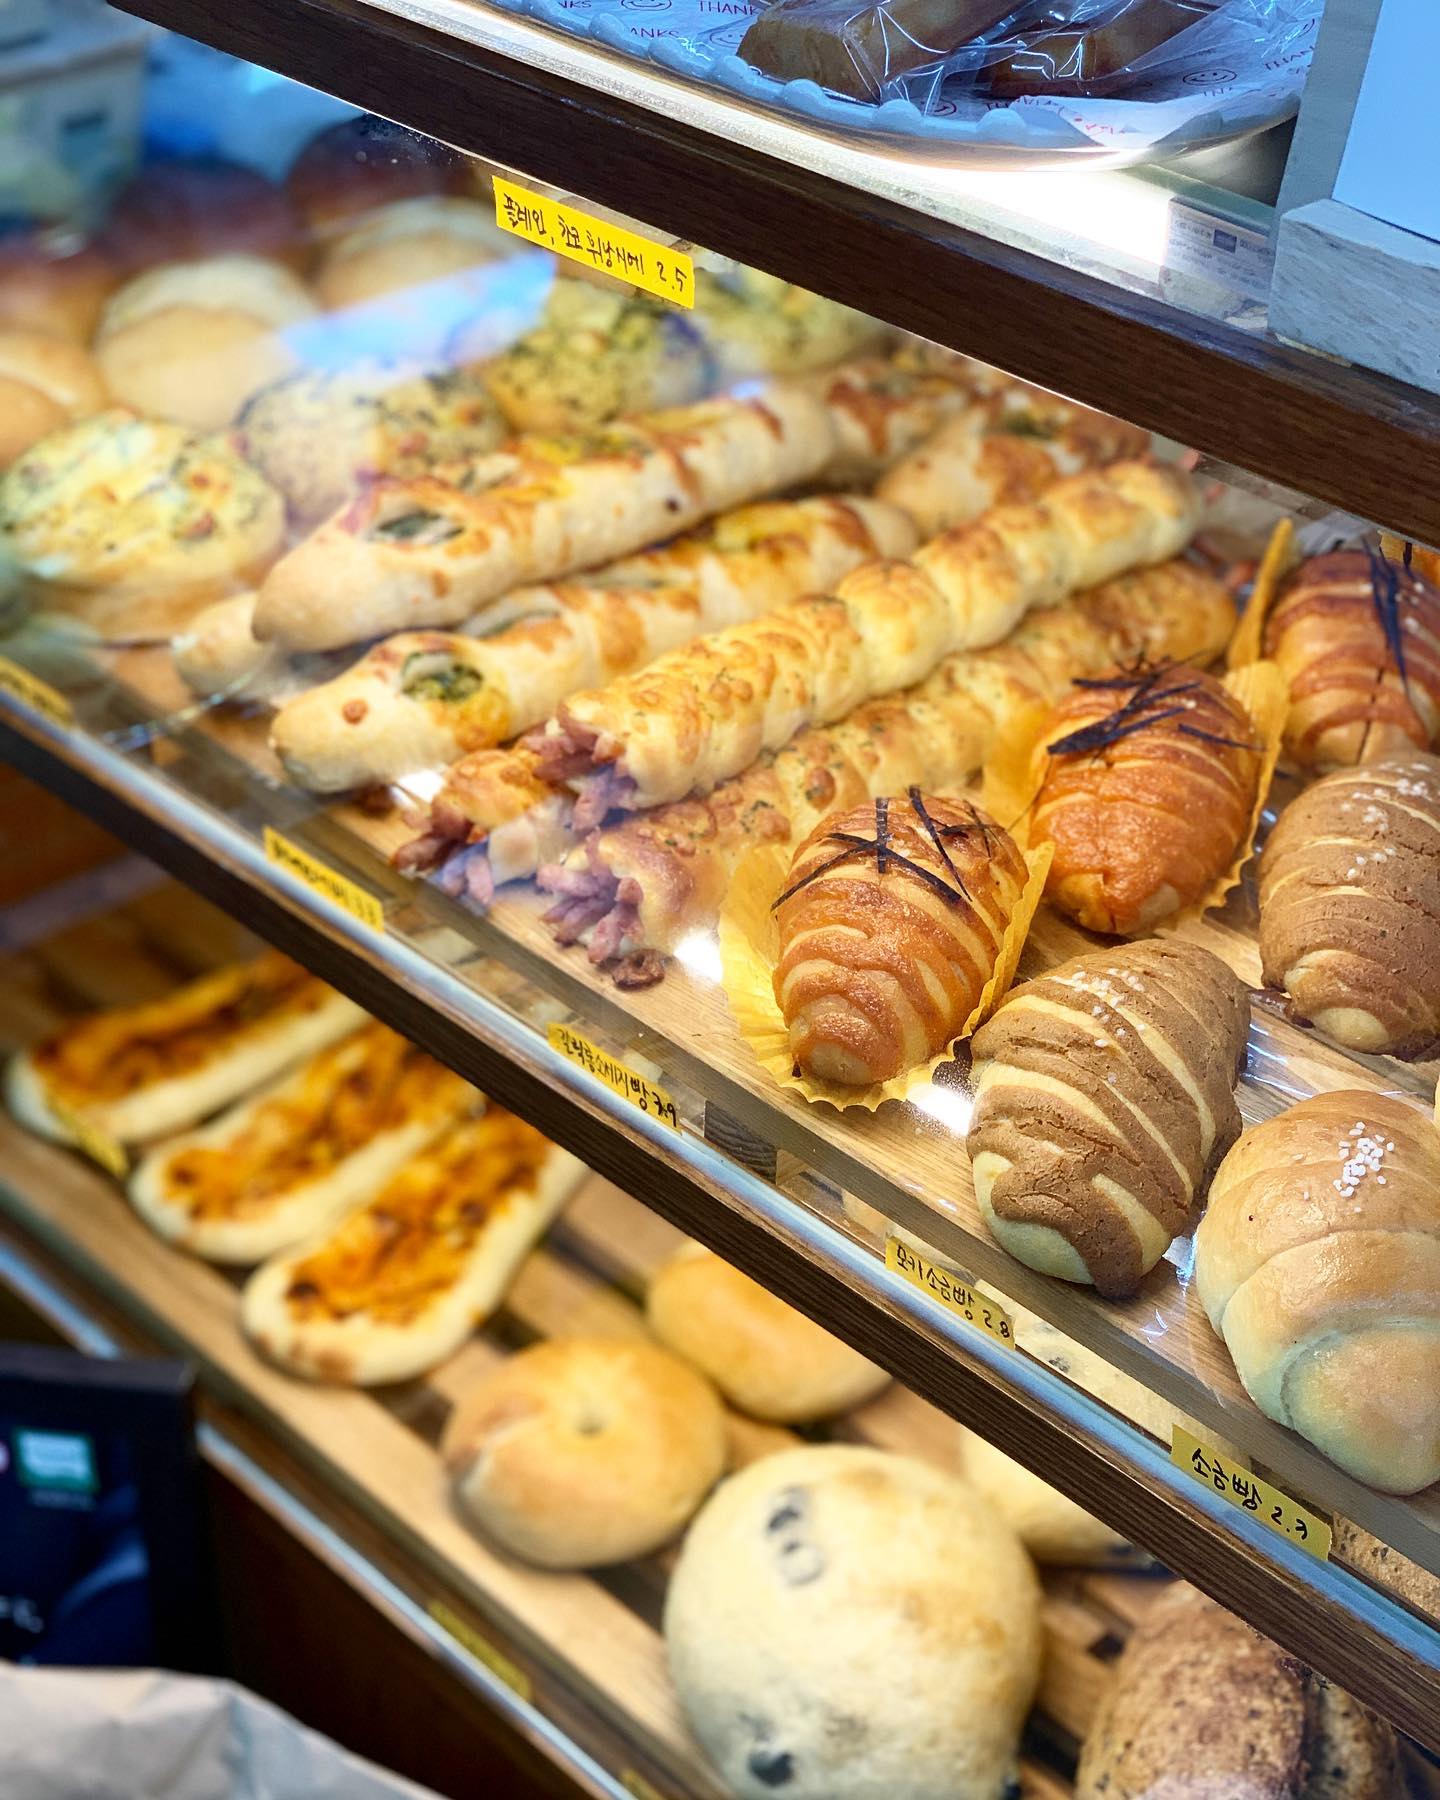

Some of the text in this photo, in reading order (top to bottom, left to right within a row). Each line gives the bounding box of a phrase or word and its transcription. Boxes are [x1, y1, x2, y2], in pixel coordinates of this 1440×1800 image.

[697, 0, 763, 16] THANK
[585, 229, 645, 276] 휘낭시에
[656, 260, 688, 292] 2.5
[982, 1309, 1011, 1339] 2.8
[1191, 1447, 1263, 1511] 소금빵
